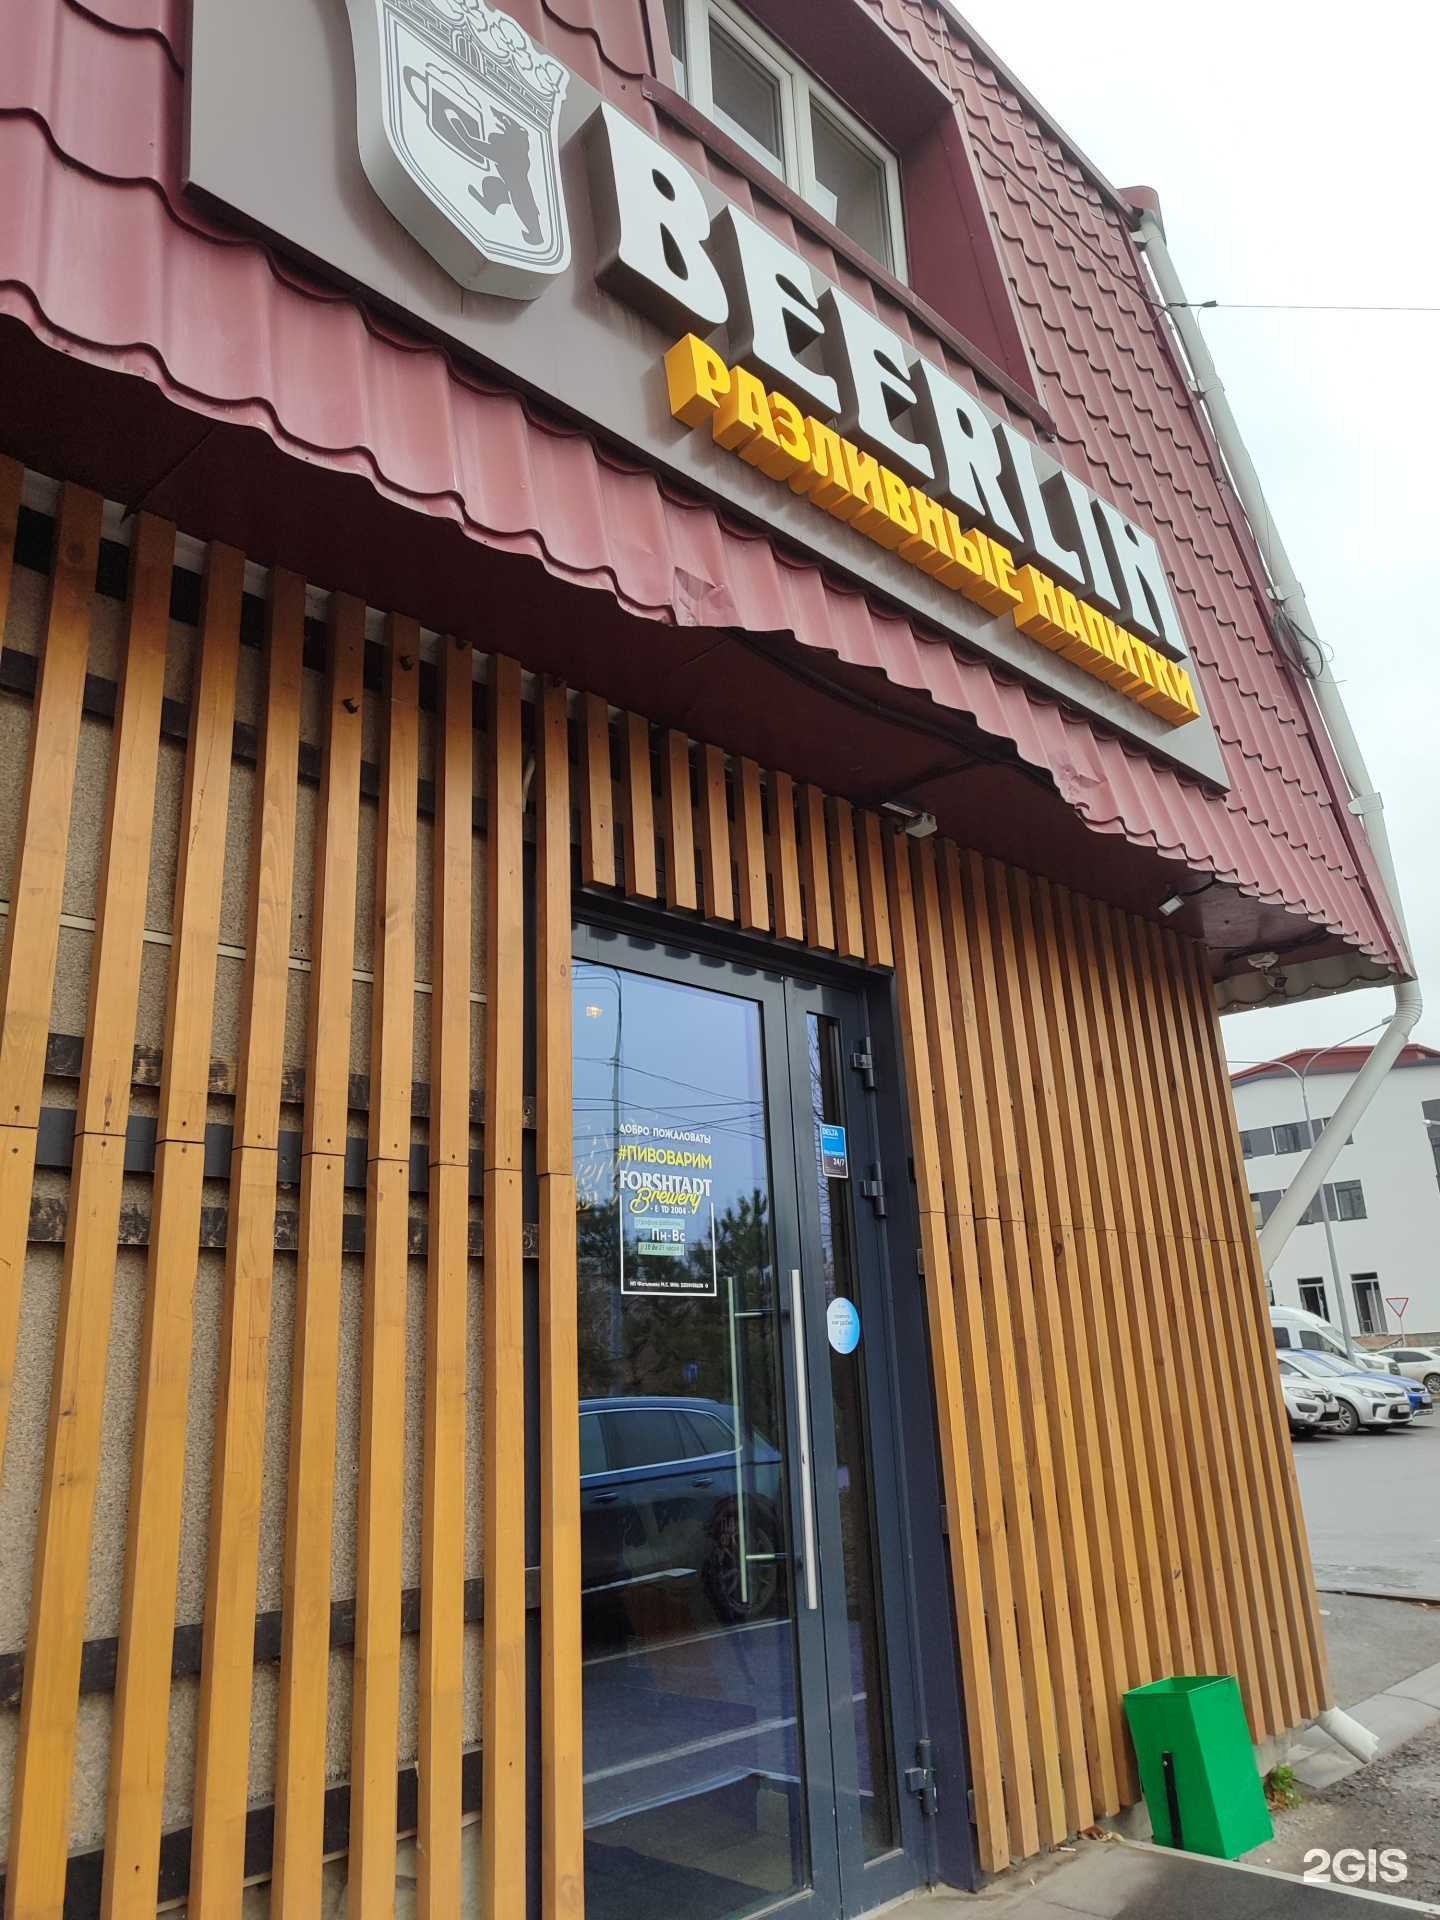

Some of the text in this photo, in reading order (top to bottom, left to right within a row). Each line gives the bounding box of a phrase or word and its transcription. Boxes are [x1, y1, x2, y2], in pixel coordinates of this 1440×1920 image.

[598, 102, 1188, 658] BEERLIN
[667, 332, 1201, 724] РАЗЛИВНЫЕ НАПИТКИ
[619, 1123, 650, 1136] ДОБРО
[618, 1144, 712, 1169] #ПИВОВАРИМ
[832, 1157, 845, 1168] 24/7
[619, 1170, 712, 1196] FORSHTADT
[629, 1187, 702, 1216] Brewery
[655, 1205, 670, 1214] ETD
[651, 1228, 686, 1242] Пн-Вс
